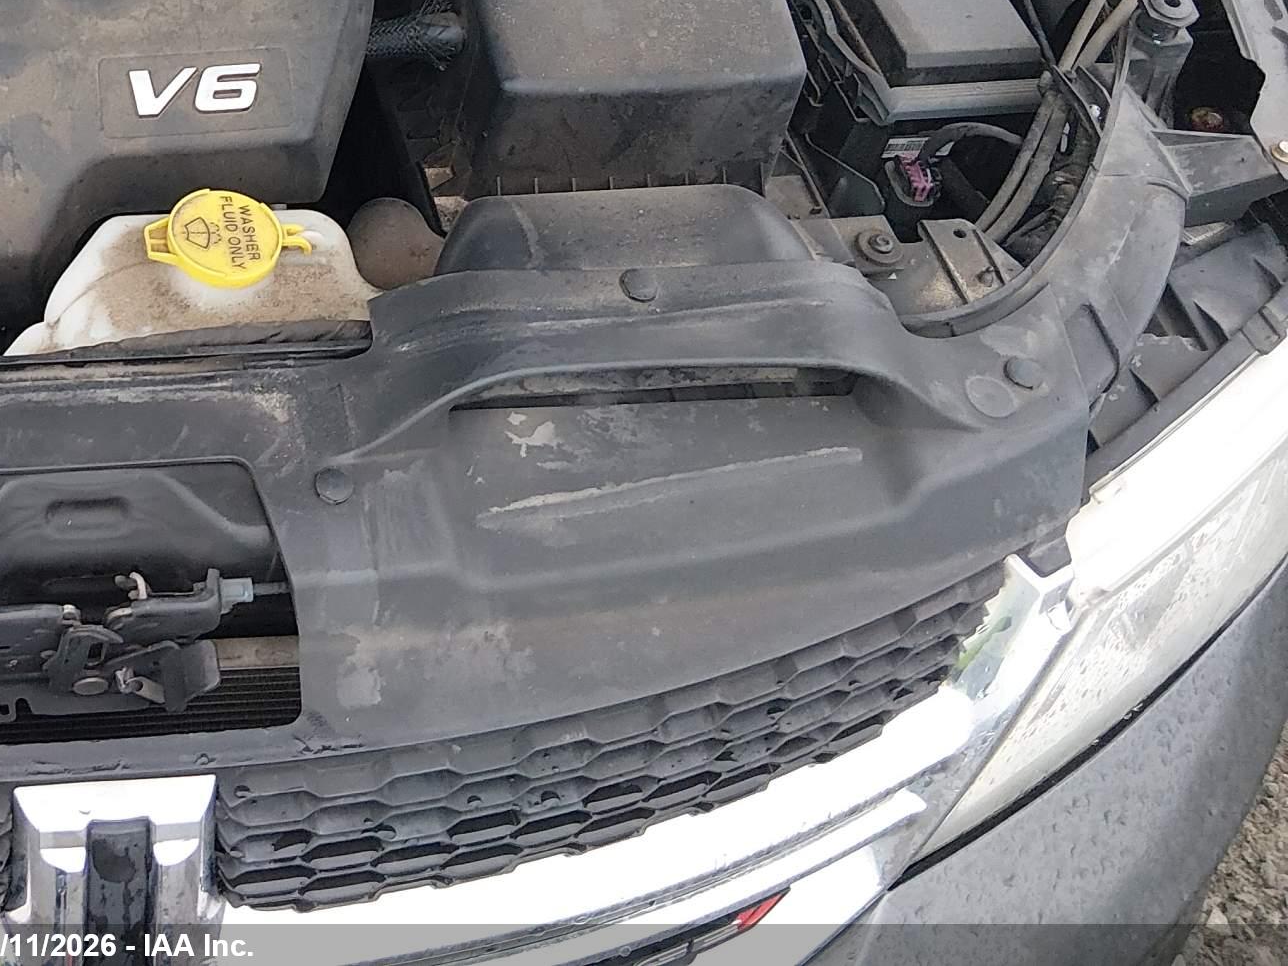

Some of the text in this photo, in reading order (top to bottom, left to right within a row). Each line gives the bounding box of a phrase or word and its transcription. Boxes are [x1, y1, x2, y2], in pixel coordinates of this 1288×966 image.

[128, 63, 261, 119] V6
[220, 196, 247, 269] FLUID ONLY
[238, 205, 261, 260] WASHER
